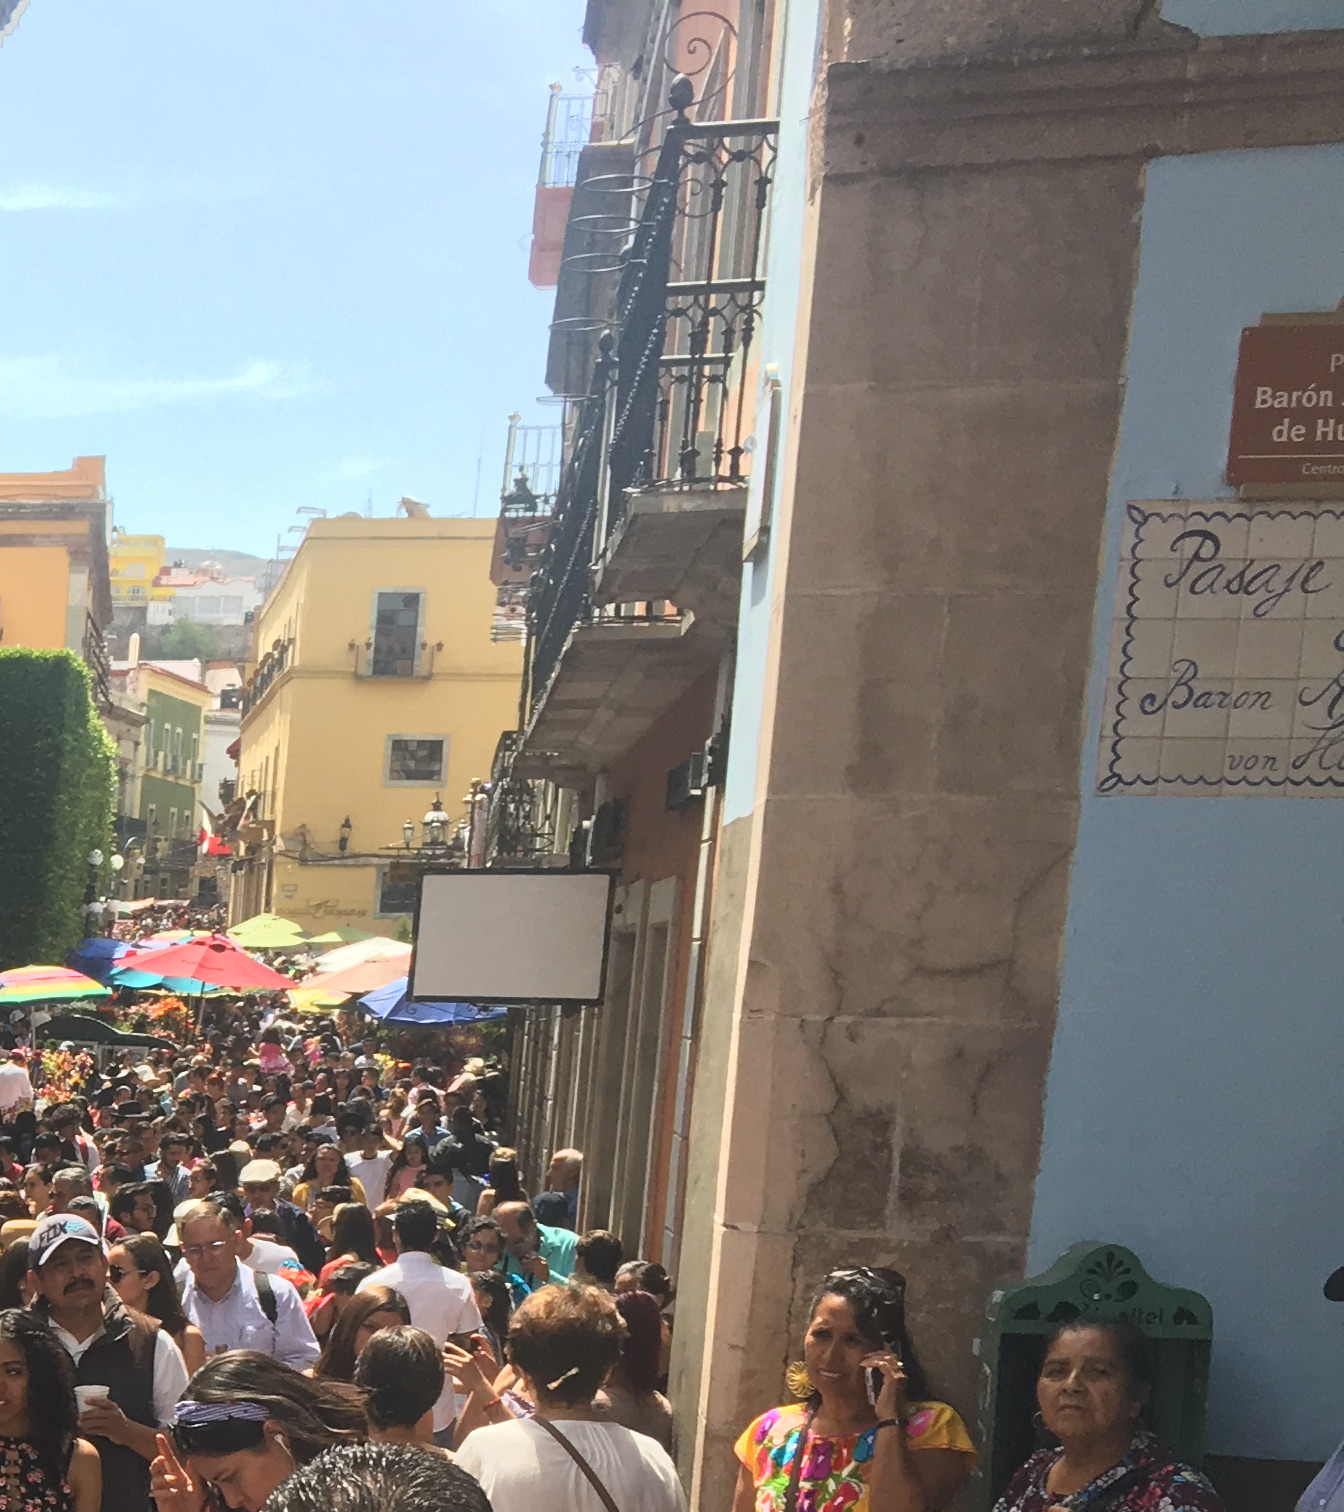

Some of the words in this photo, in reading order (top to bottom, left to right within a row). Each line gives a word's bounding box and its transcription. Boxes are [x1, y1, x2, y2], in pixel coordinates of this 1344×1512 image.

[1255, 383, 1333, 409] Barón
[1272, 418, 1306, 442] de
[1164, 530, 1333, 618] Pasaje
[1139, 658, 1272, 715] Baron
[1227, 754, 1279, 771] von
